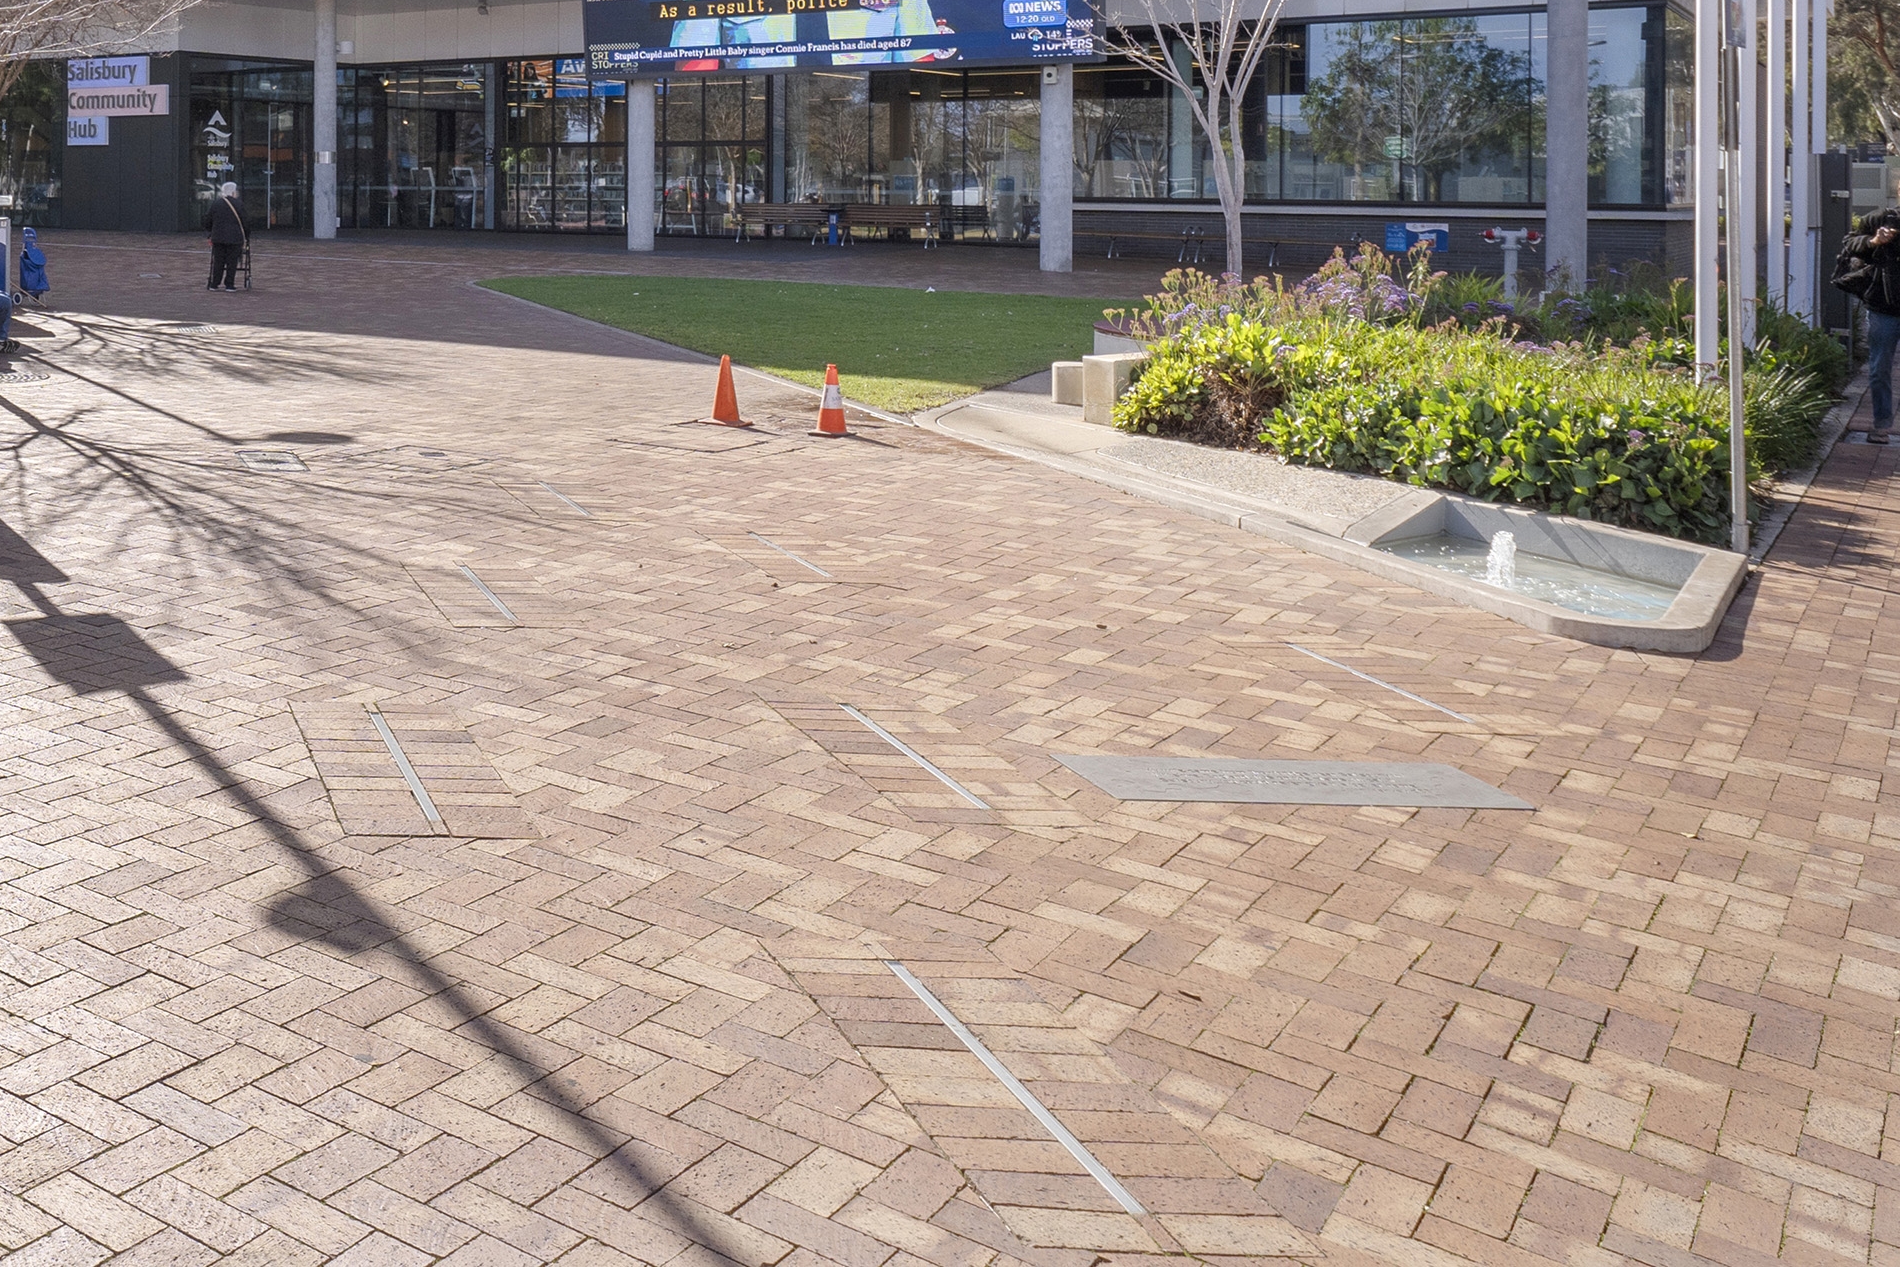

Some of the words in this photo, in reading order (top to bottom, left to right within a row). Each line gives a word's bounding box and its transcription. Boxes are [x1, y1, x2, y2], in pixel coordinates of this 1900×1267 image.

[659, 4, 678, 18] As
[688, 5, 697, 16] a
[1025, 0, 1062, 13] NEWS
[1015, 14, 1039, 23] 12:20
[1011, 32, 1026, 40] LAU
[614, 50, 639, 62] Stupid
[639, 50, 662, 61] Cupid
[663, 49, 678, 58] and
[679, 48, 703, 60] Pretty
[704, 47, 726, 56] Little
[727, 46, 747, 57] Baby
[748, 46, 775, 56] singer
[775, 44, 806, 54] Connie
[807, 42, 839, 52] Francis
[841, 41, 857, 51] has
[858, 40, 877, 50] died
[878, 40, 899, 51] aged
[900, 38, 912, 47] 87
[68, 60, 137, 84] Salisbury
[69, 88, 157, 113] Community
[68, 118, 97, 138] Hub
